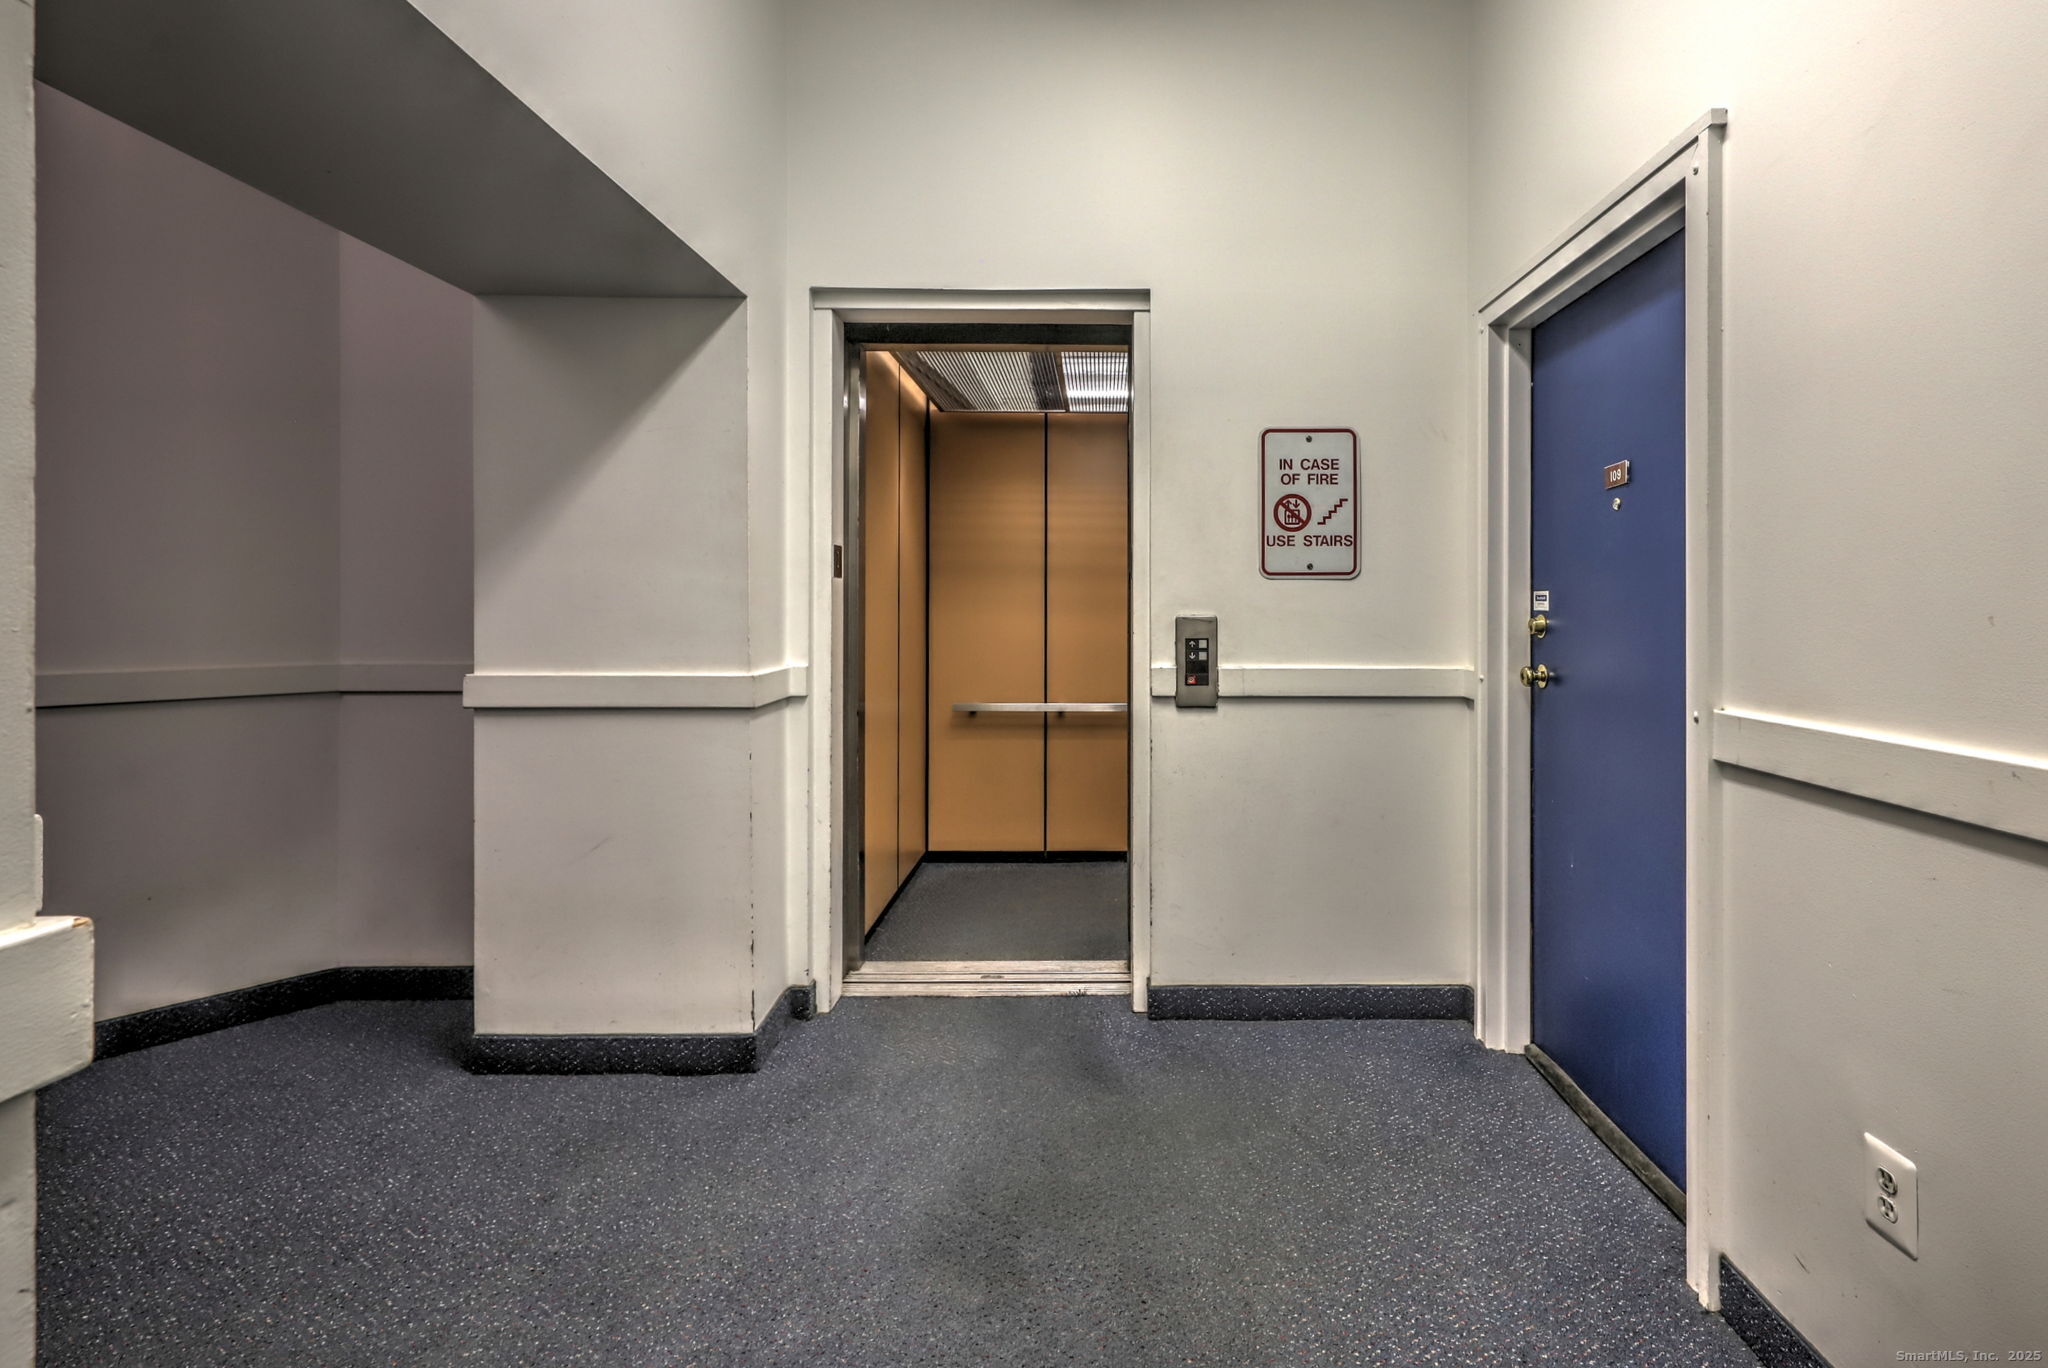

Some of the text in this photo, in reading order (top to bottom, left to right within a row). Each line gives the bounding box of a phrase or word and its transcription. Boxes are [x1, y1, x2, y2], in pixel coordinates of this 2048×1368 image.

[1279, 458, 1340, 470] IN CASE
[1280, 473, 1339, 485] OF FIRE
[1610, 468, 1621, 482] 109
[1266, 535, 1353, 547] USE STAIRS
